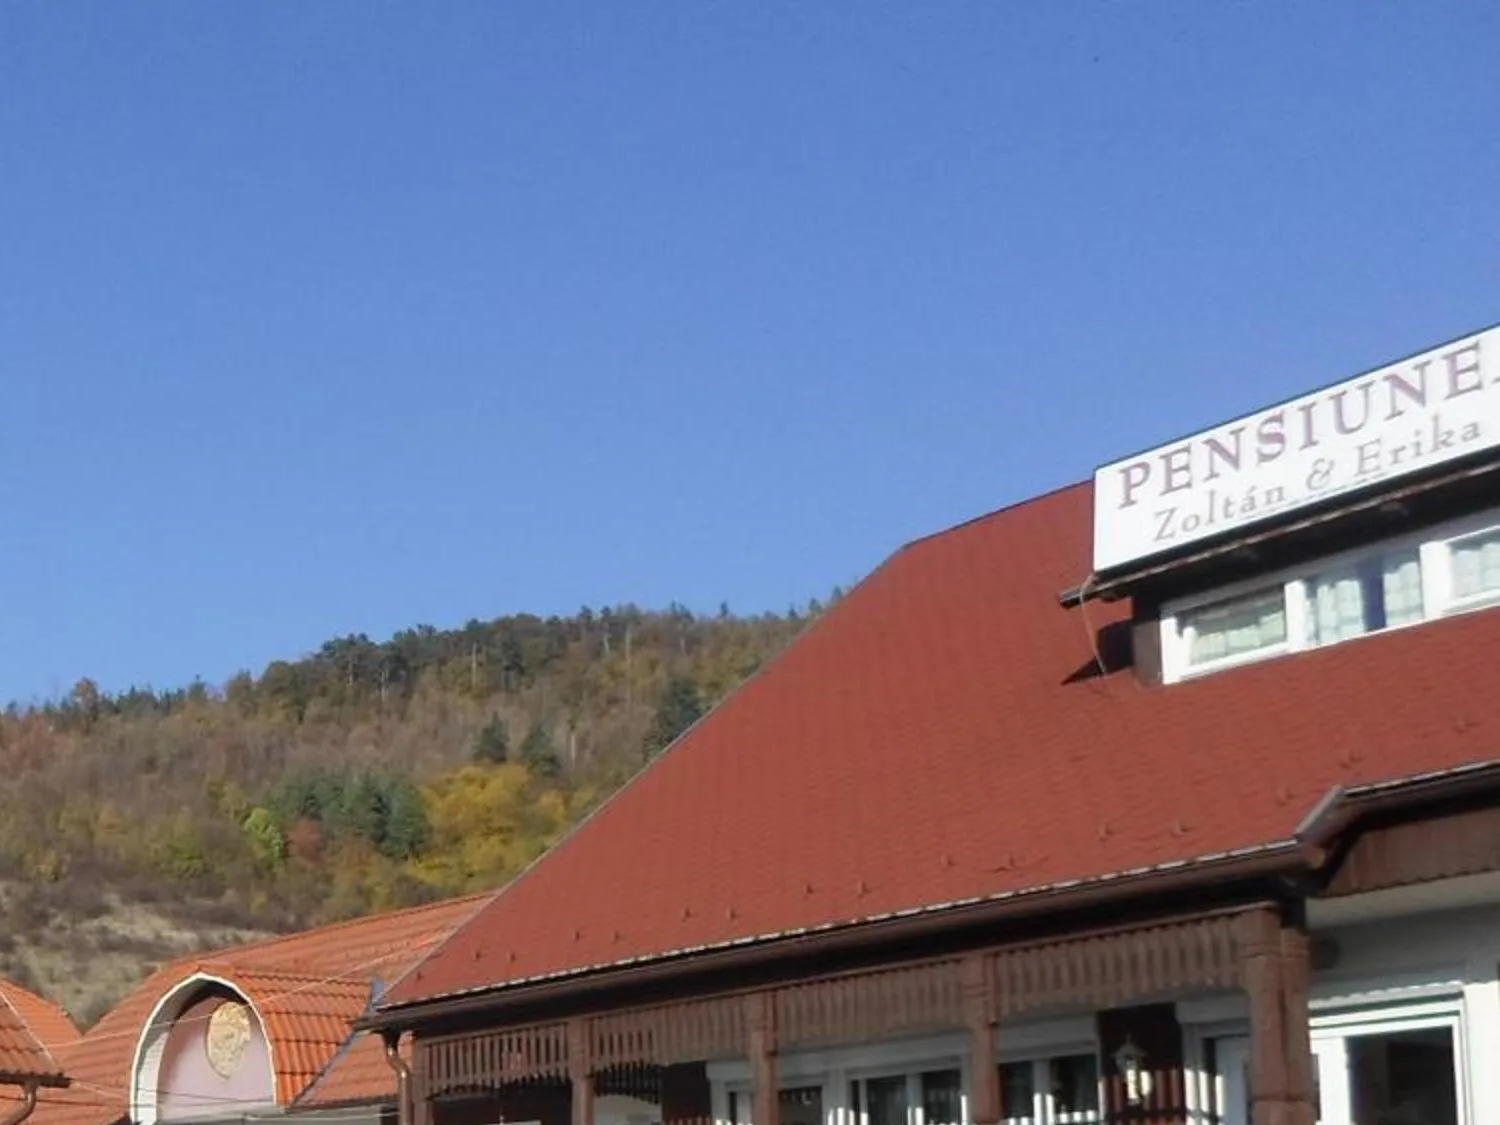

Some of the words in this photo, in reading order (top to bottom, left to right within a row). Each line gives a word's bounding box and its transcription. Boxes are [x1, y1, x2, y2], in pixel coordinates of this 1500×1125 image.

[1117, 340, 1500, 509] PENSIUNE
[1153, 488, 1286, 543] Zoltán
[1305, 457, 1335, 492] &
[1355, 413, 1482, 477] Erika
